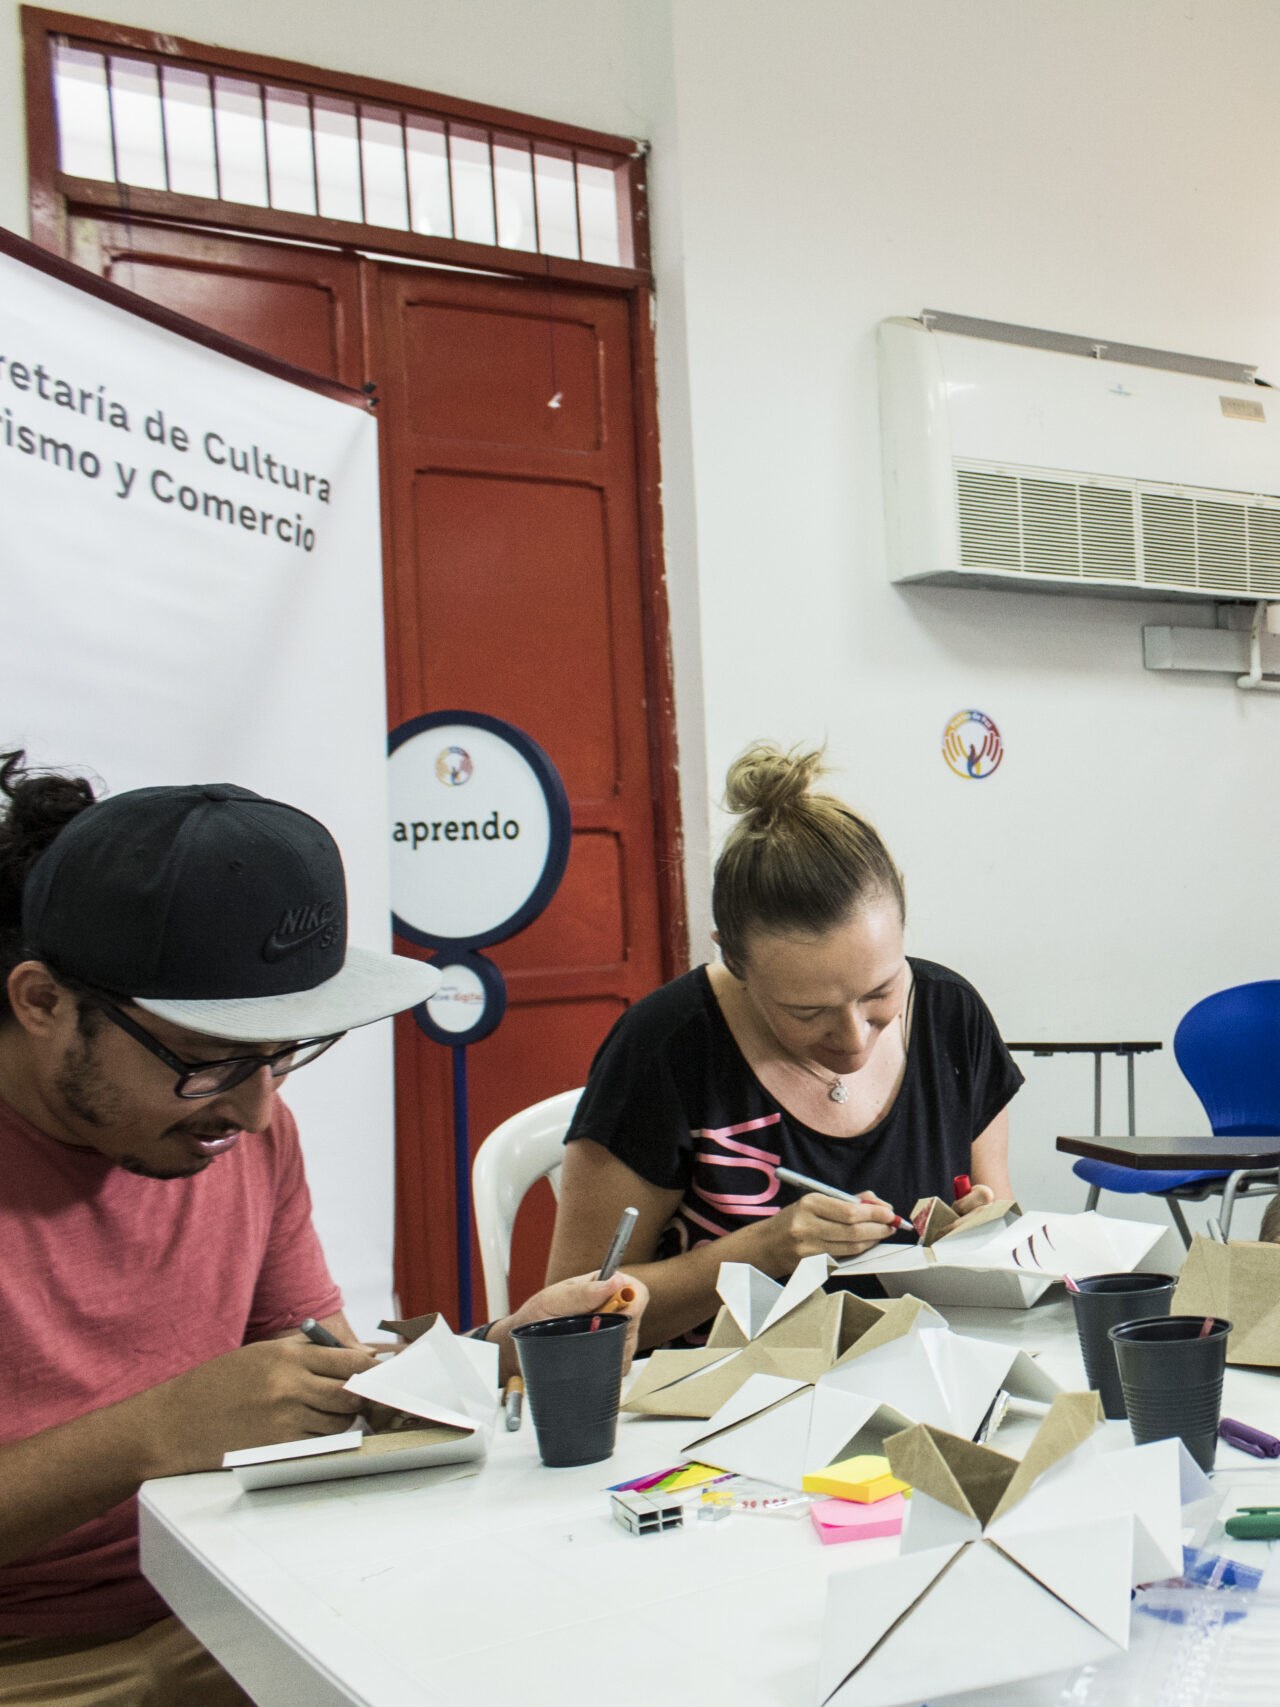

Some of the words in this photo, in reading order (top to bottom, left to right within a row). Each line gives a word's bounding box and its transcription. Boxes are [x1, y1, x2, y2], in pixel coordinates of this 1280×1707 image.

[0, 407, 101, 478] ismo
[115, 461, 137, 499] y
[150, 469, 315, 552] Comercio
[145, 410, 188, 452] de
[203, 431, 331, 504] Cultura
[392, 811, 520, 850] aprendo
